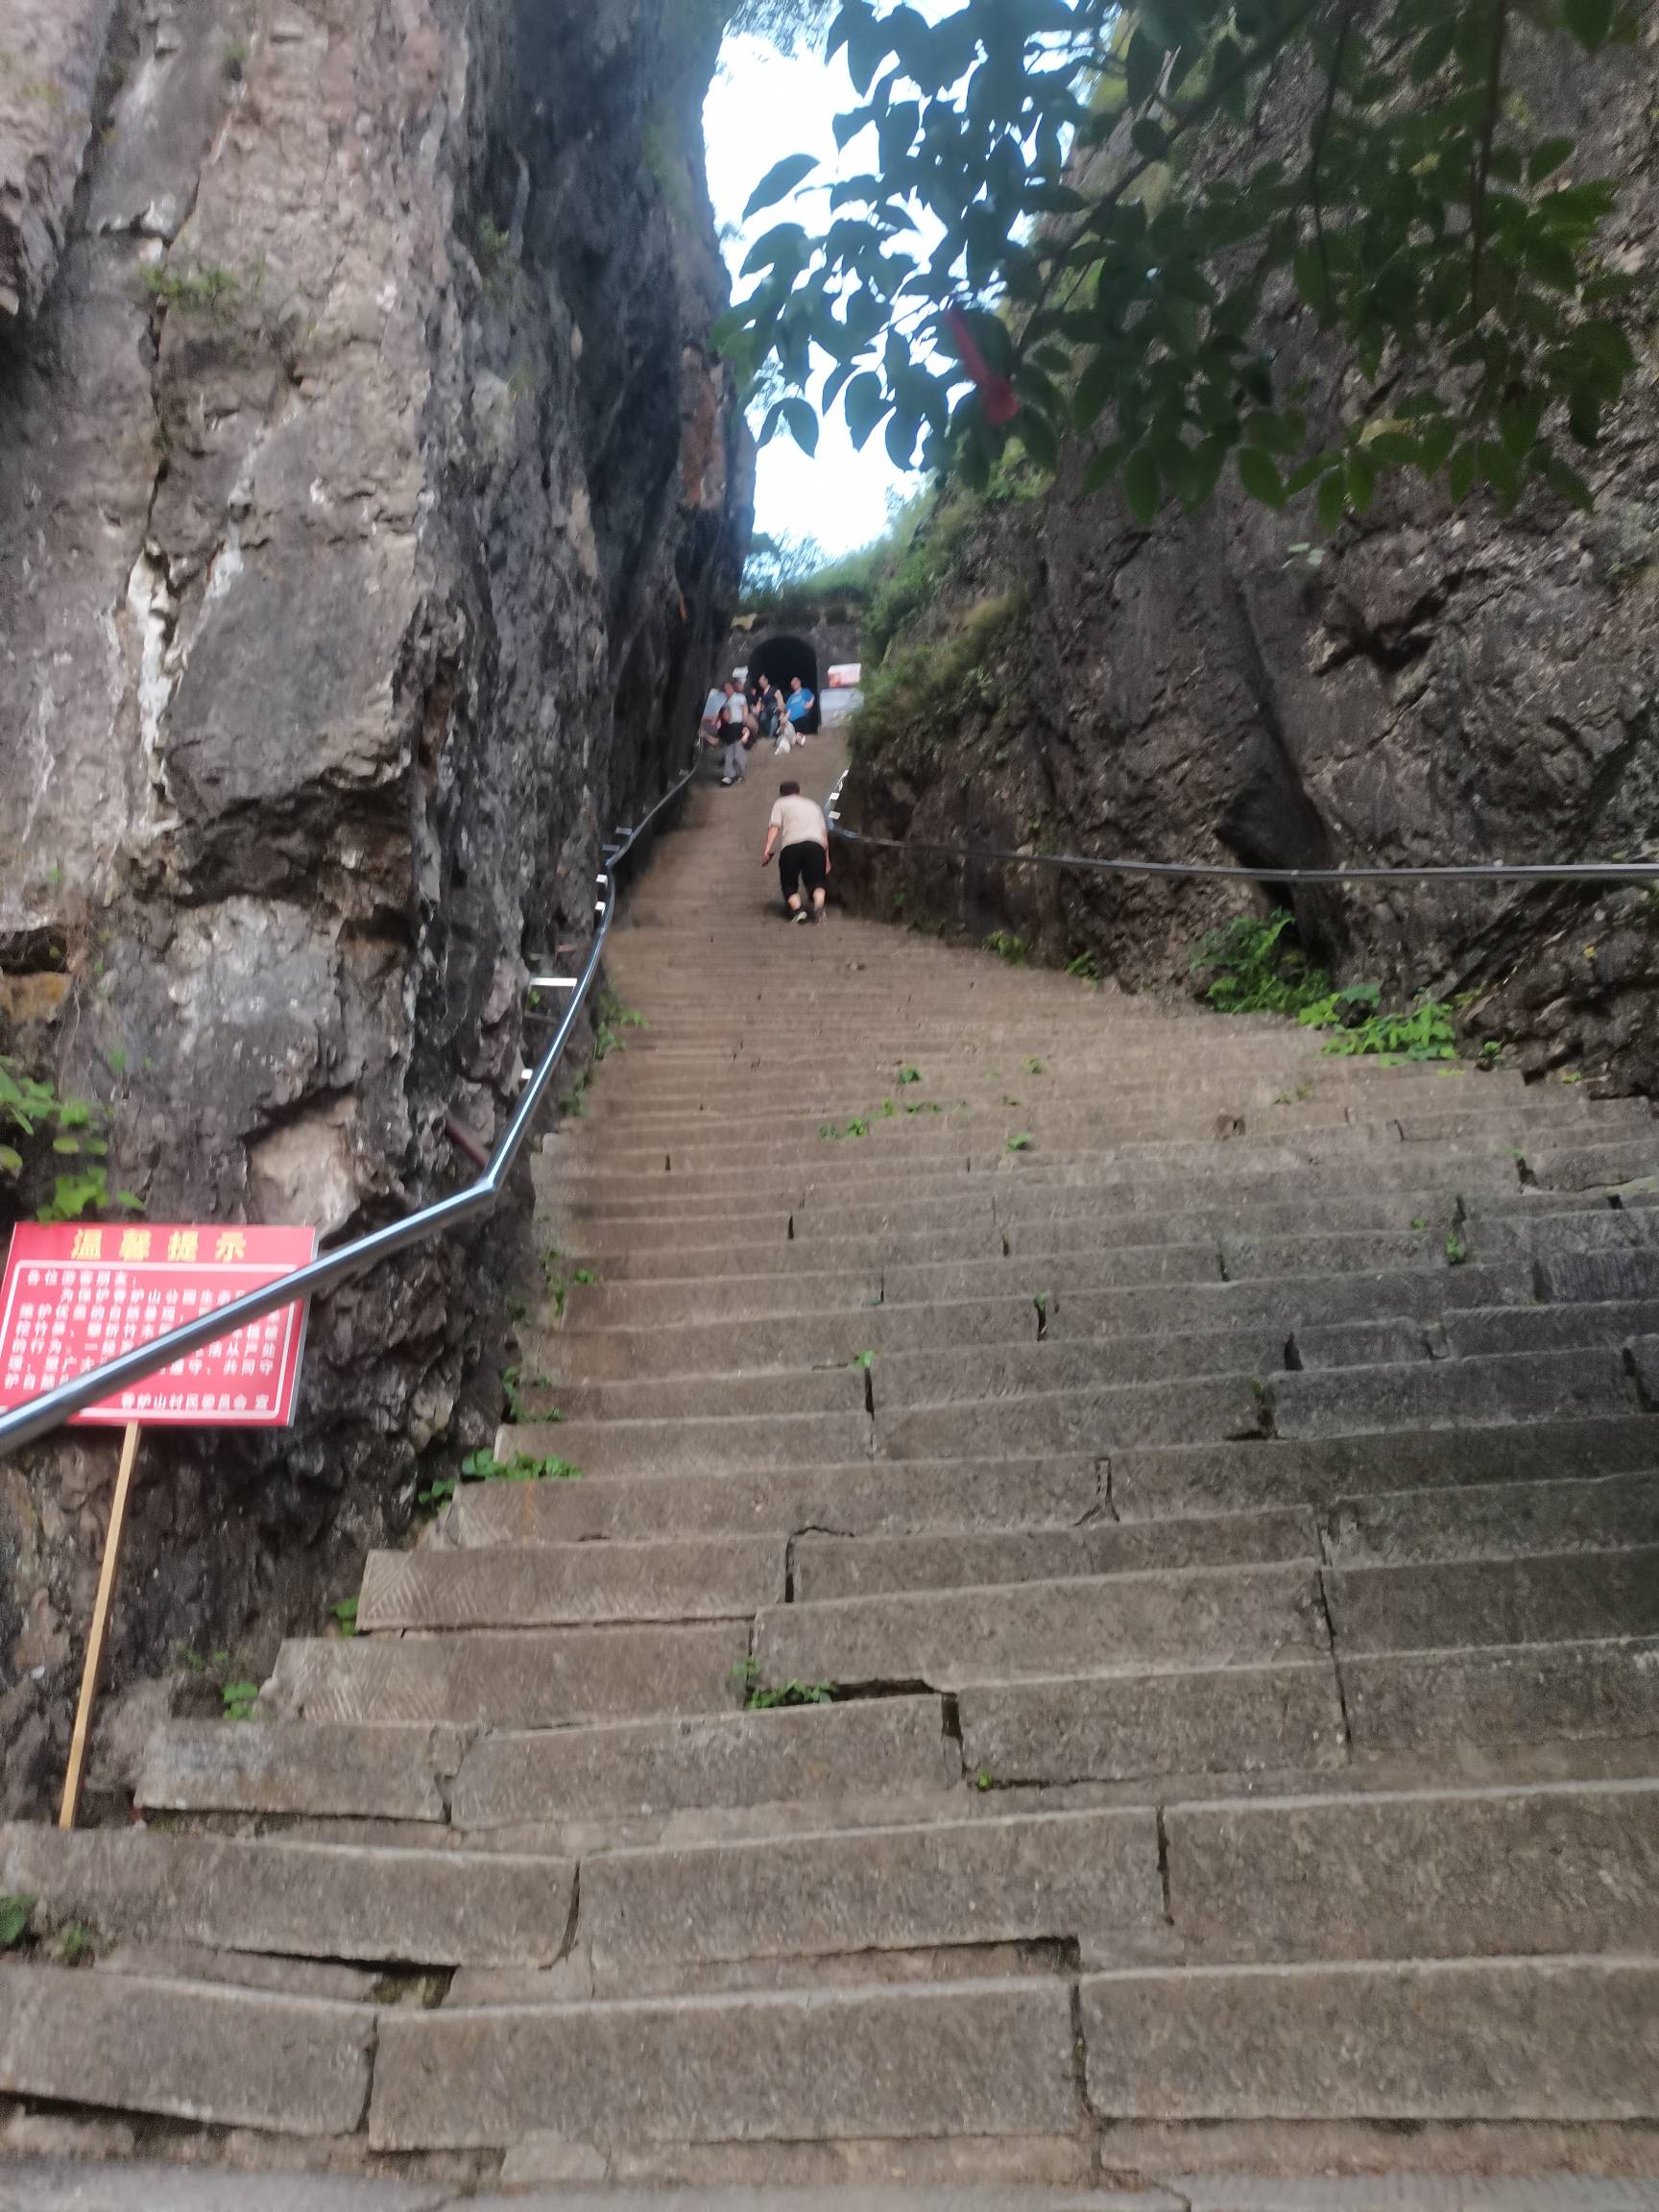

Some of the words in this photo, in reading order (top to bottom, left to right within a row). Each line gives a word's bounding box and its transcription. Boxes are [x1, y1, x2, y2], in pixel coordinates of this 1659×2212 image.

[70, 1229, 247, 1262] 温馨提示
[60, 1287, 247, 1307] 为保护香炉山公园生态
